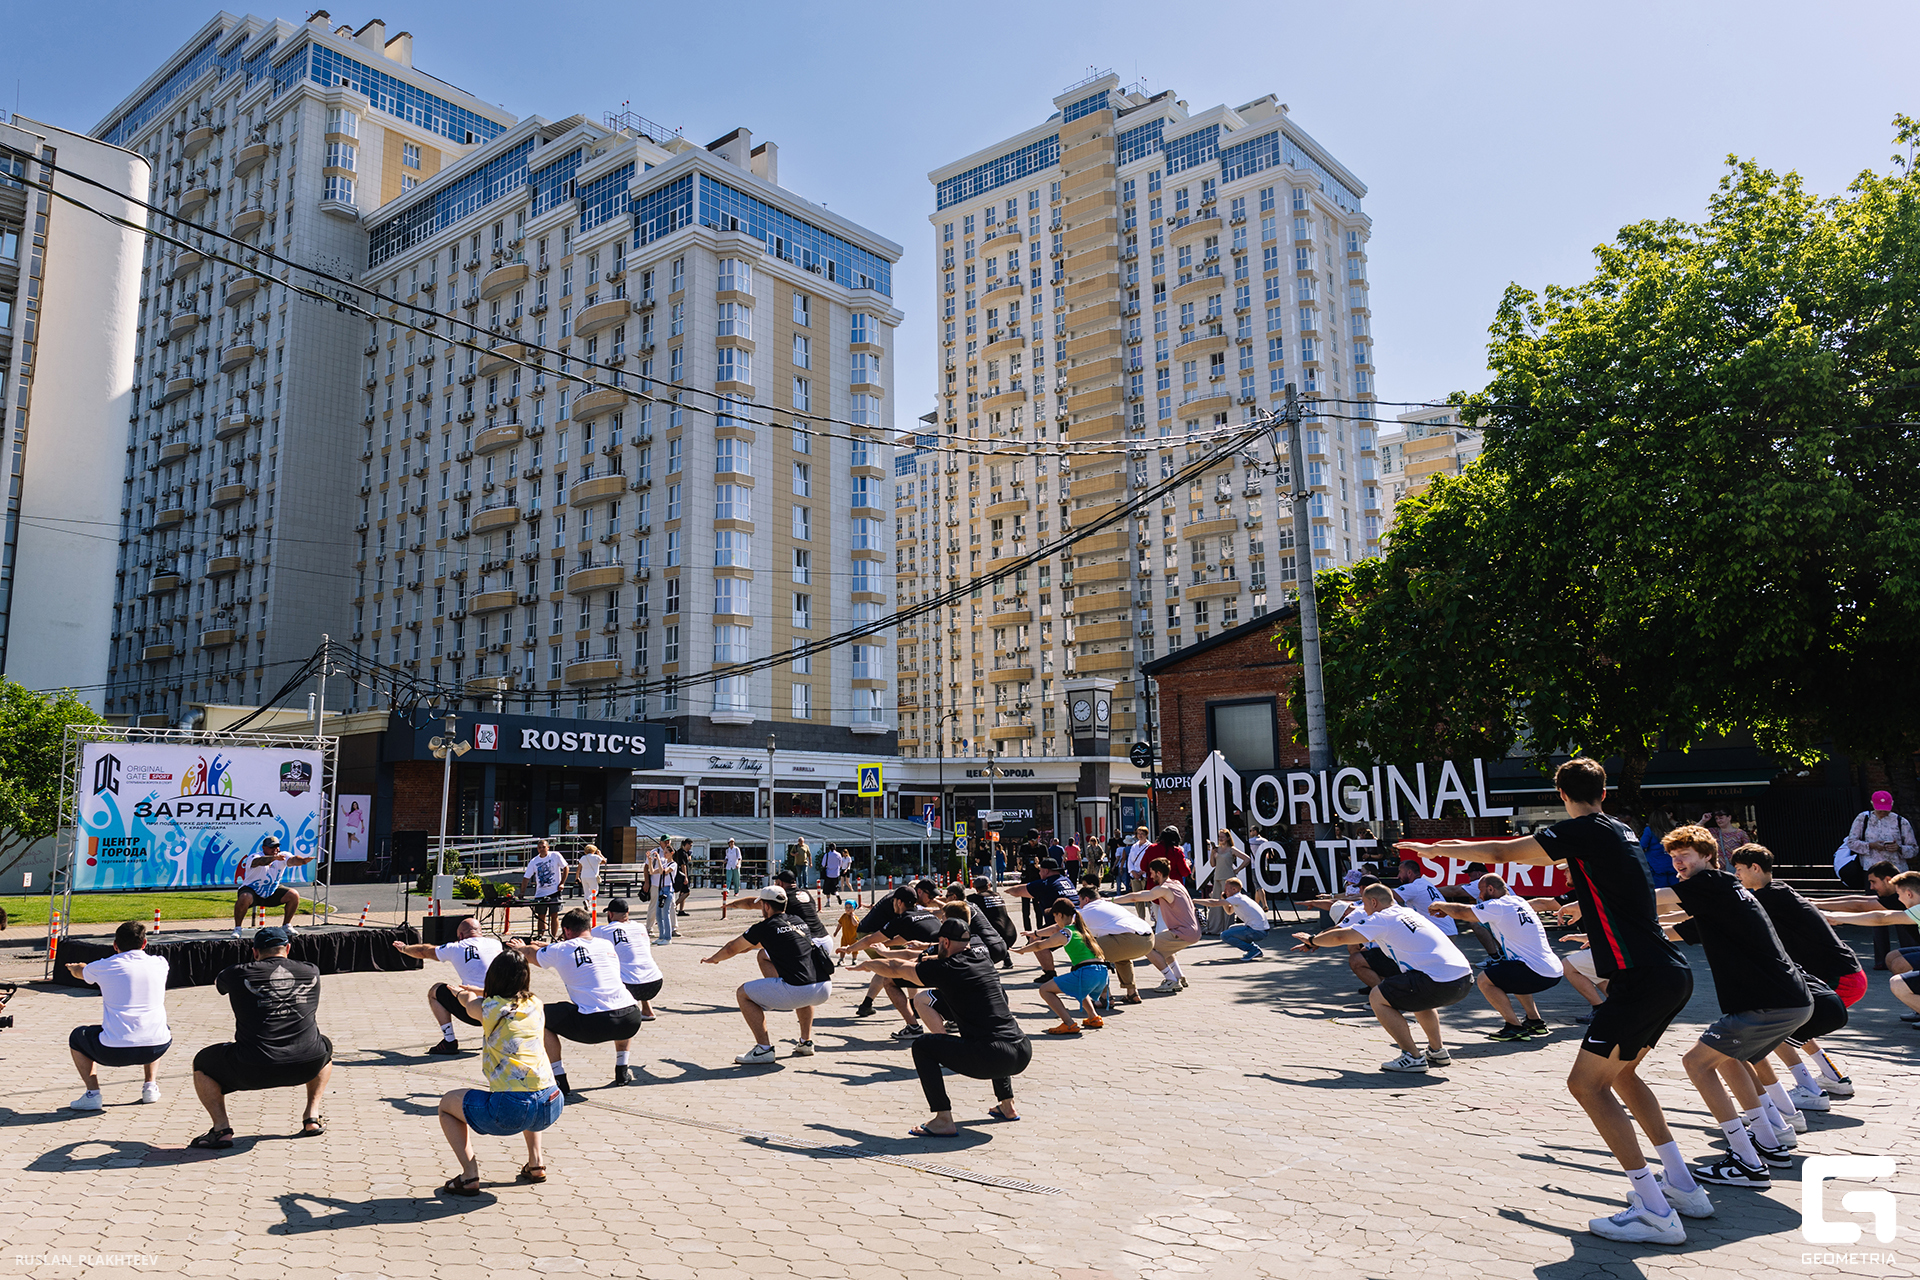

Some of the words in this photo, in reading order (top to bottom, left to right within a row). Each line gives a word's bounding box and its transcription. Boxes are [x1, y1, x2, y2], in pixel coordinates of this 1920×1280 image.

[520, 728, 646, 754] ROSTIC'S
[738, 757, 762, 776] Повар
[1002, 769, 1035, 777] ОРОДА
[1250, 757, 1513, 826] ORIGINAL
[134, 803, 274, 820] ЗАРЯДКА
[1018, 809, 1033, 818] FM
[102, 837, 140, 847] ЦЕНТР
[102, 848, 147, 857] ГОРОДА
